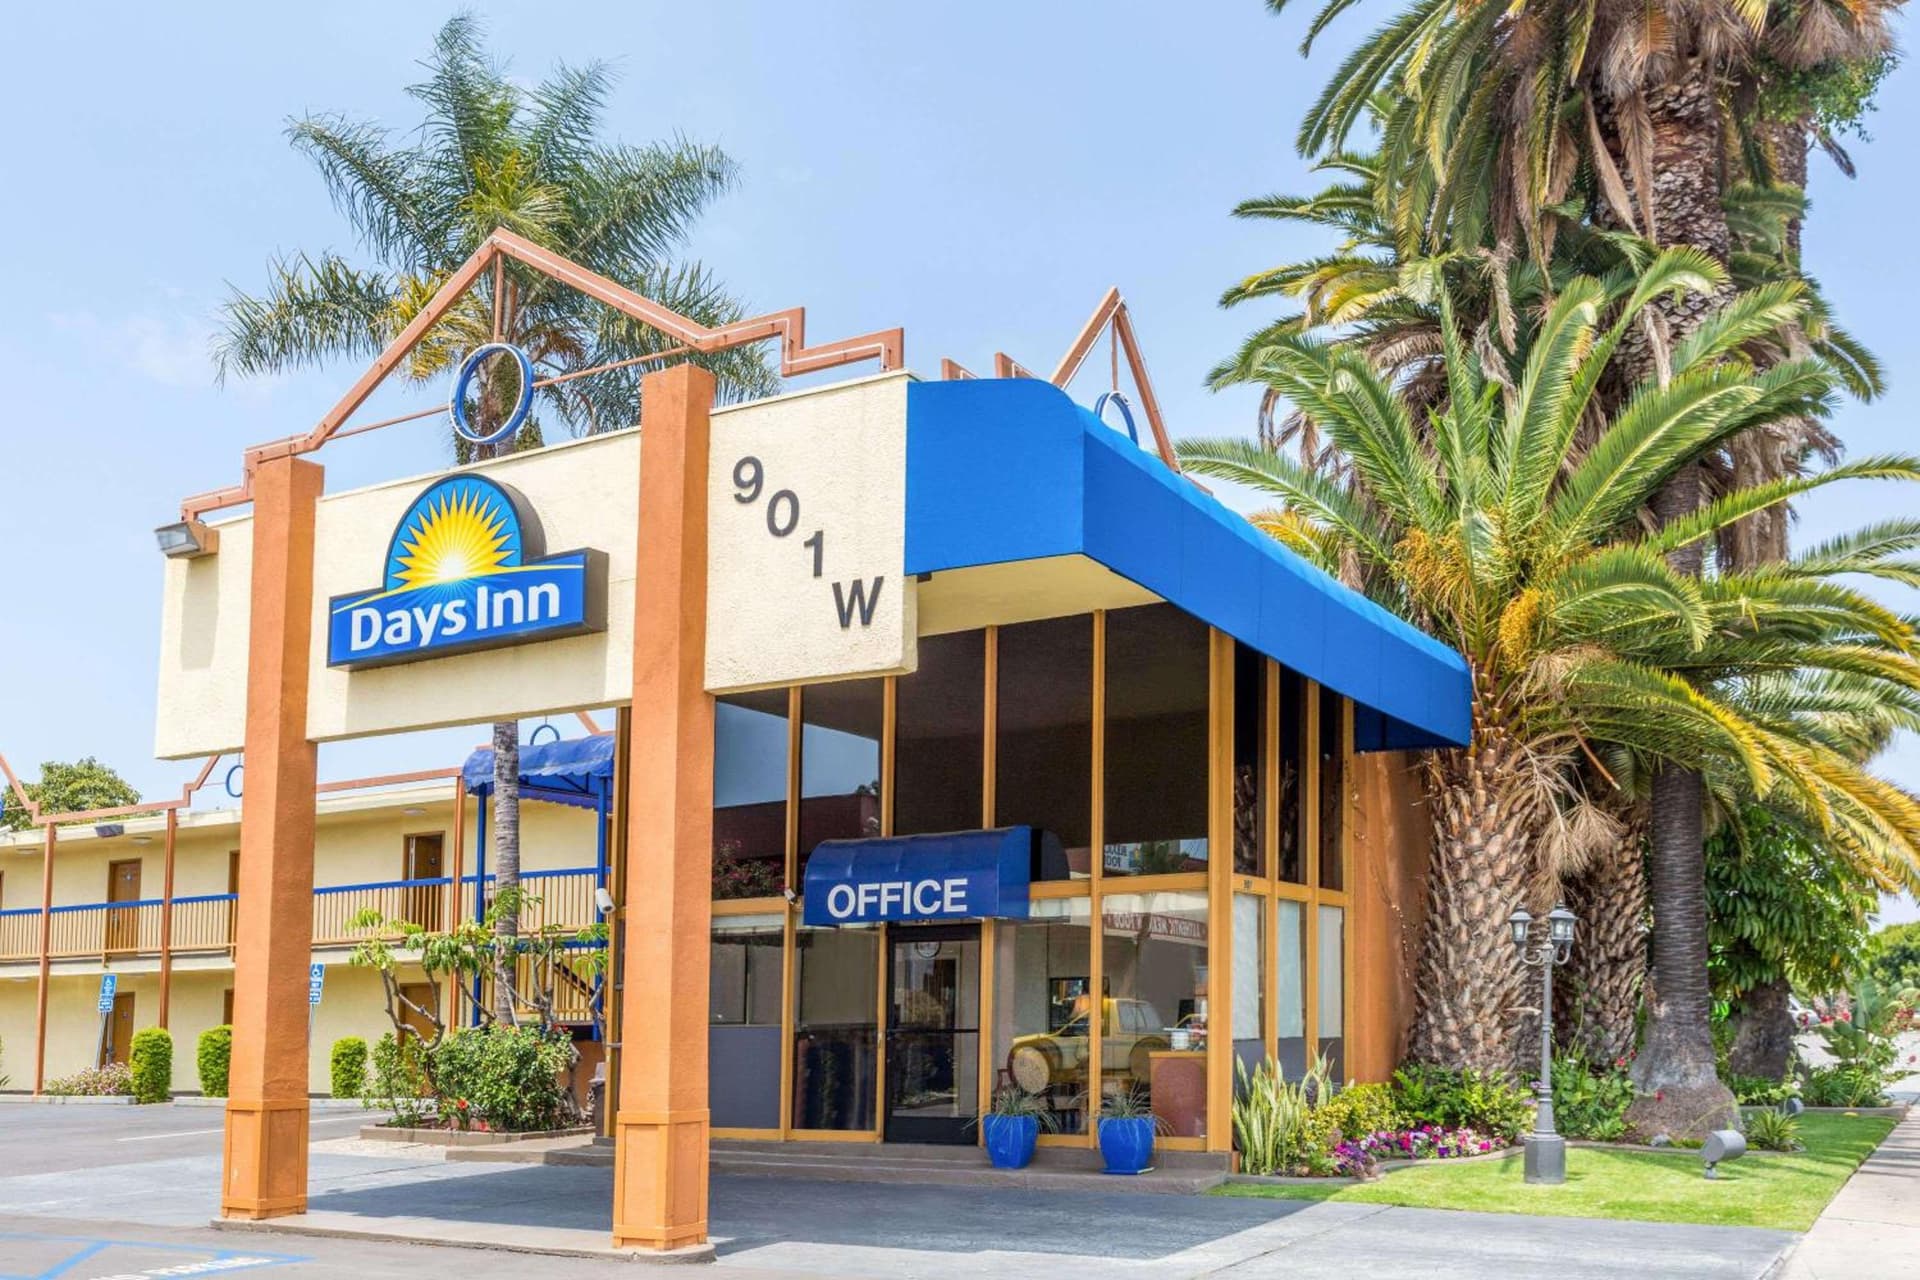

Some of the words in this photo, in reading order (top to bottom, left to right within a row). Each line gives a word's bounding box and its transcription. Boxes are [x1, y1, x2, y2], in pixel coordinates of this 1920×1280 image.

[732, 455, 824, 578] 901
[831, 575, 885, 630] W
[350, 599, 467, 652] Days
[476, 582, 561, 631] Inn
[826, 877, 969, 918] OFFICE
